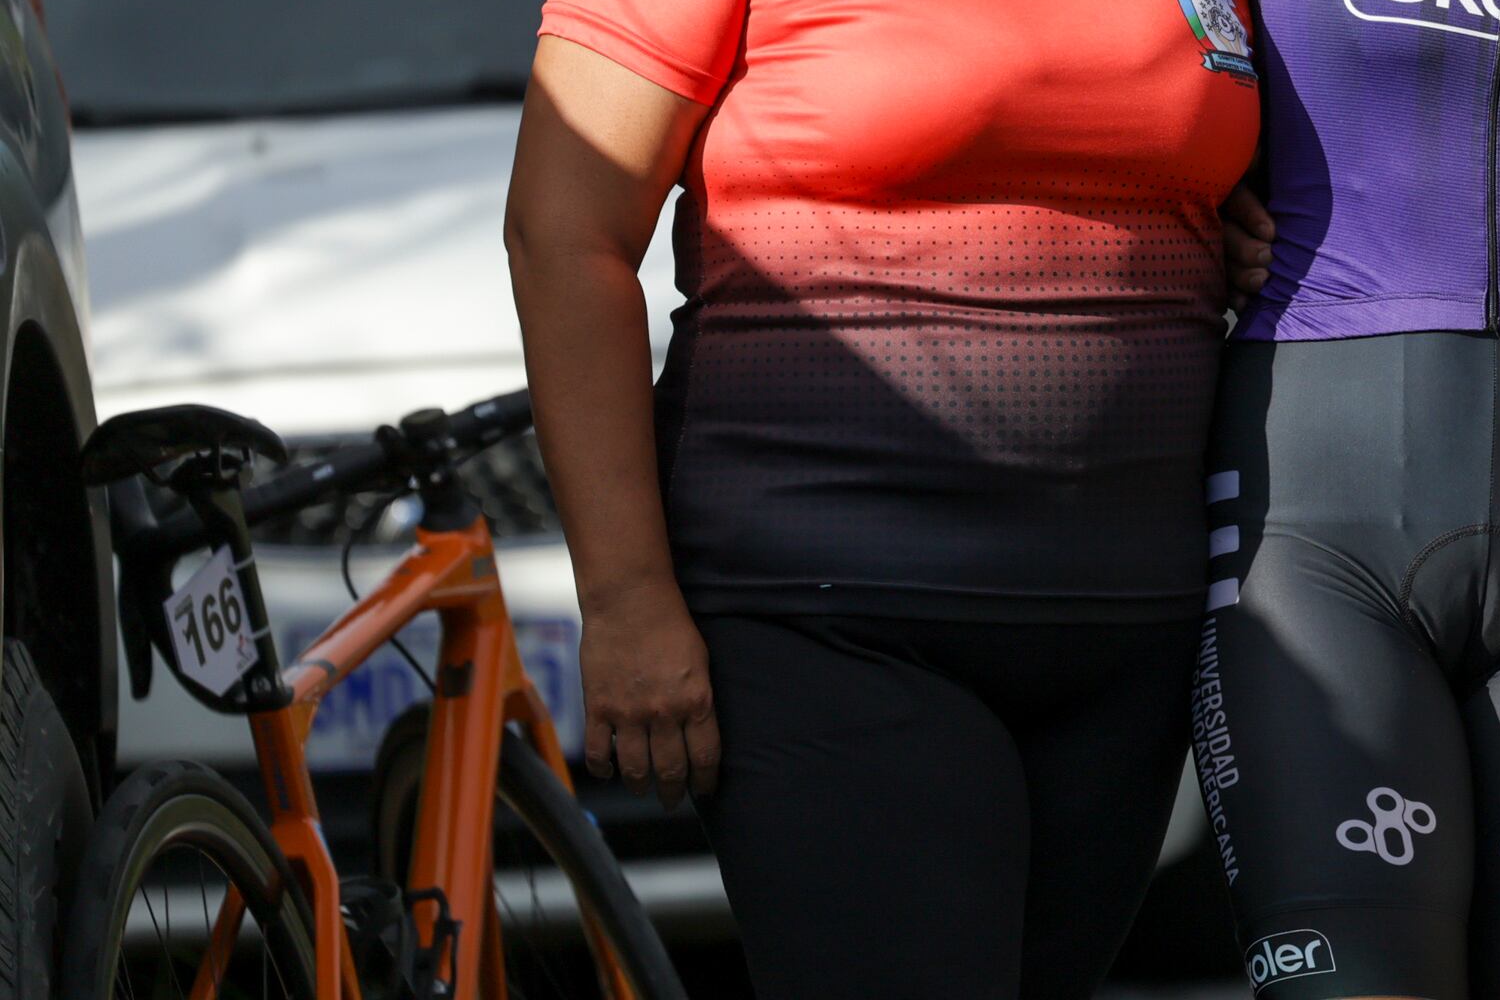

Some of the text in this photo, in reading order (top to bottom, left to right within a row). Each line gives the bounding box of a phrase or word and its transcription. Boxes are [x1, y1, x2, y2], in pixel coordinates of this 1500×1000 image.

[182, 577, 242, 667] 166
[1200, 617, 1239, 789] UNIVERSIDAD
[1248, 939, 1321, 988] oler
